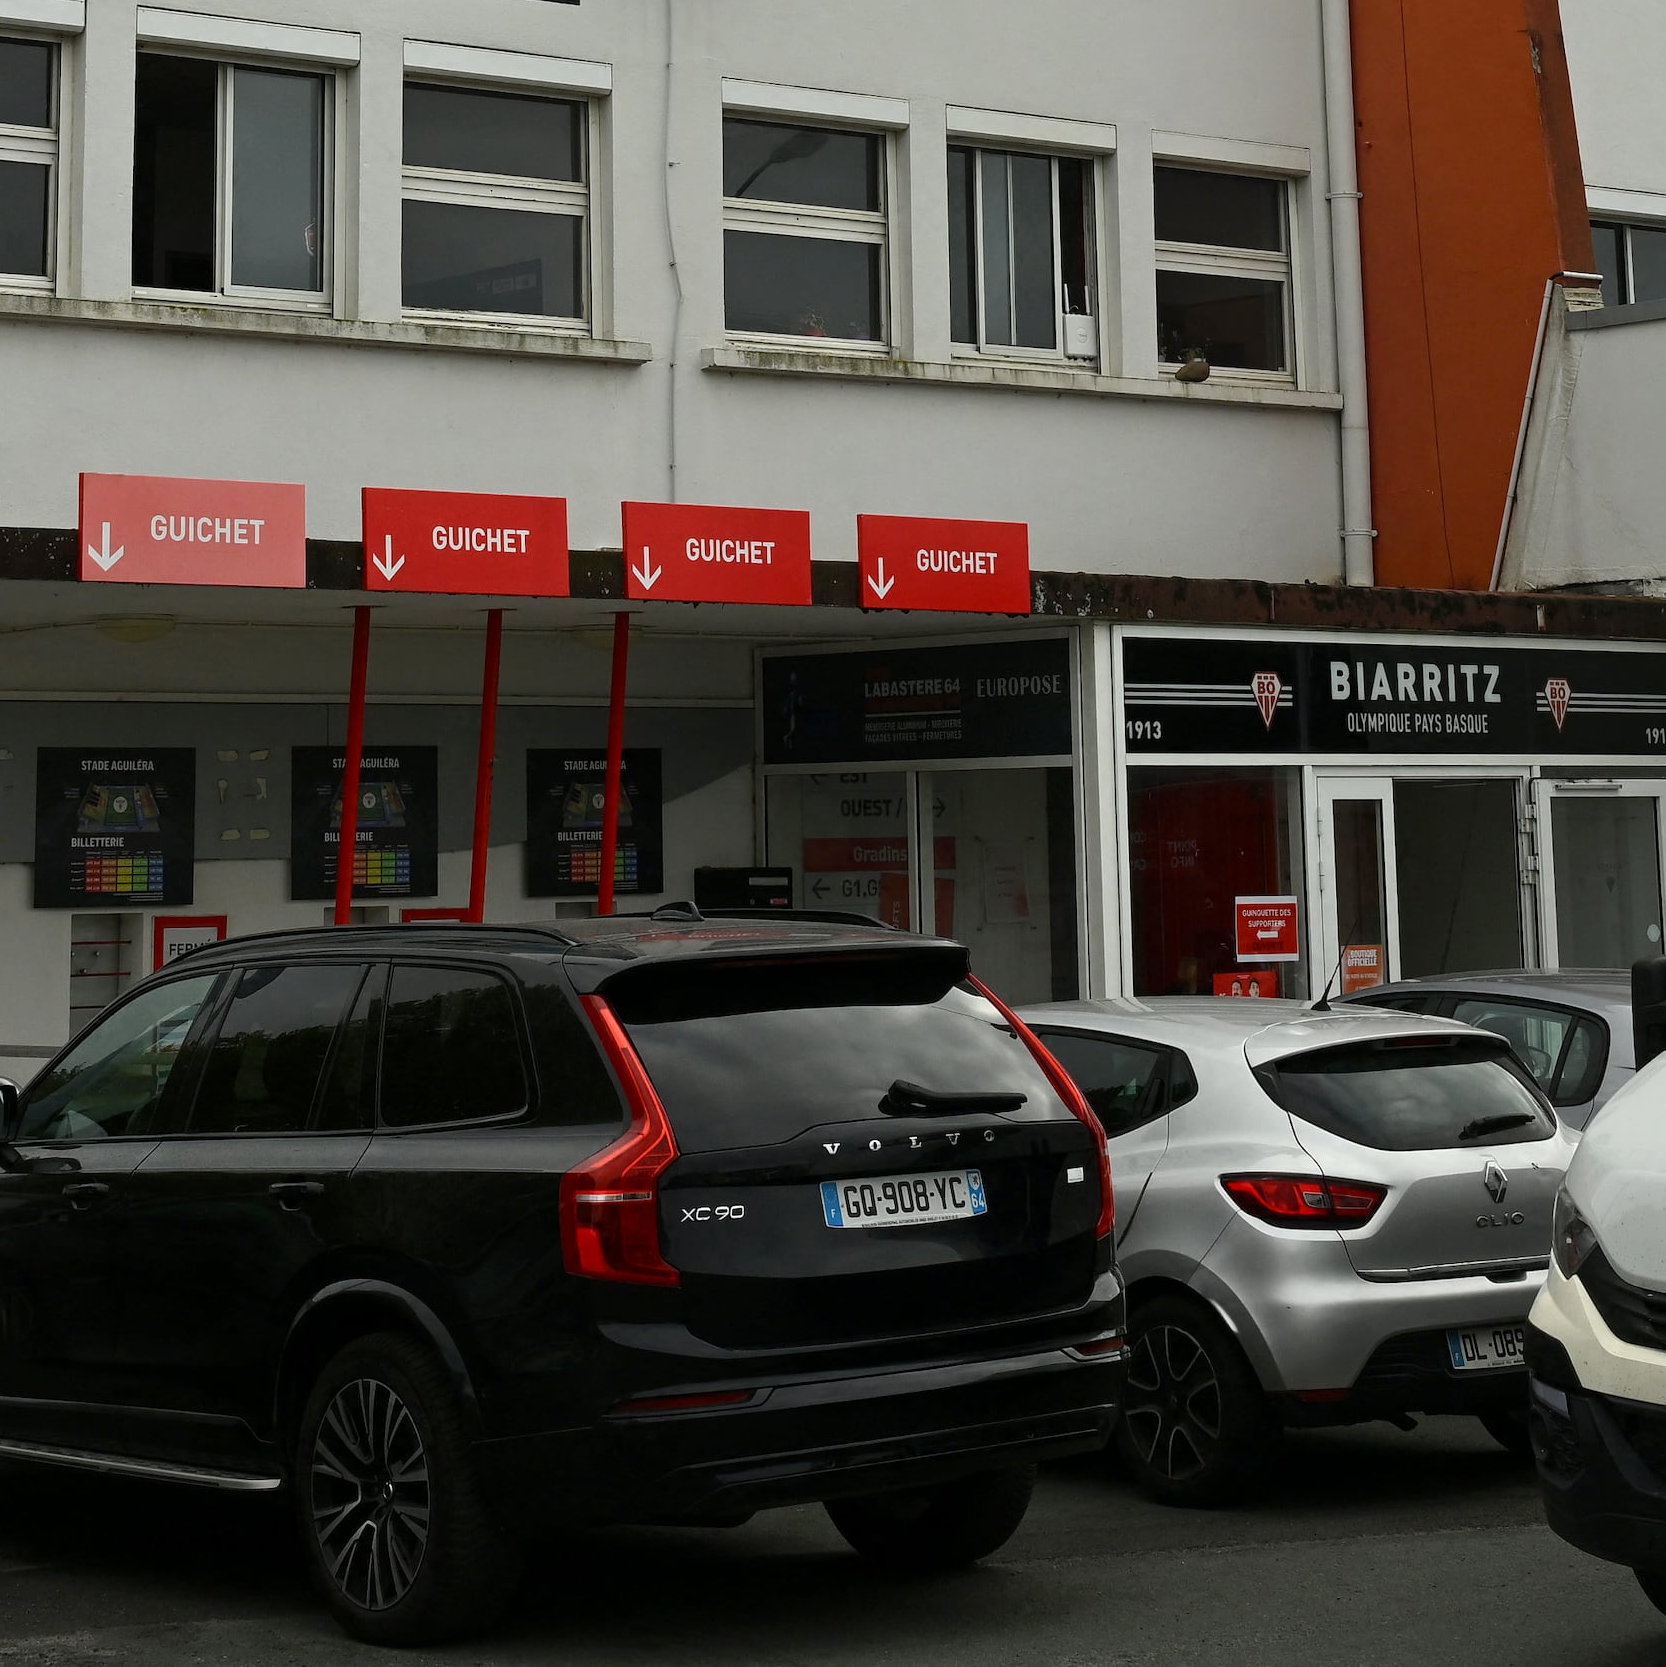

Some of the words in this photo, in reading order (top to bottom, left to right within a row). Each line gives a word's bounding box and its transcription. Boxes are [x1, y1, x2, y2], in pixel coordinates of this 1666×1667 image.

[150, 514, 265, 546] GUICHET
[432, 525, 530, 555] GUICHET
[685, 537, 775, 566] GUICHET
[916, 548, 997, 576] GUICHET
[864, 679, 943, 698] LABASTERE
[944, 678, 961, 694] 64
[976, 675, 1062, 698] EUROPOSE
[1257, 680, 1275, 695] BO
[1330, 661, 1502, 703] BIARRITZ
[1549, 686, 1567, 700] BO
[1125, 720, 1162, 740] 1913
[1347, 712, 1411, 735] OLYMPIQUE
[1414, 713, 1443, 734] PAYS
[1445, 713, 1488, 735] BASQUE
[81, 760, 110, 771] STADE
[111, 759, 155, 771] AGUILÉRA
[360, 757, 400, 768] AGUILÉRA
[564, 760, 588, 771] STADE
[841, 799, 892, 817] OUEST
[71, 837, 125, 848] BILLETTERIE
[324, 831, 374, 843] BILLERIE
[557, 831, 603, 842] BILLETTERIE
[853, 845, 907, 863] Gradins
[1279, 909, 1292, 917] DES
[1248, 919, 1286, 928] SUPPORTERS
[169, 938, 212, 956] FER
[1348, 957, 1378, 967] OFFICIELLE
[823, 1130, 996, 1155] VOLVO
[831, 1208, 837, 1219] F
[843, 1177, 966, 1218] GQ-908-YC
[971, 1191, 985, 1210] 64
[1476, 1211, 1525, 1229] CLIO
